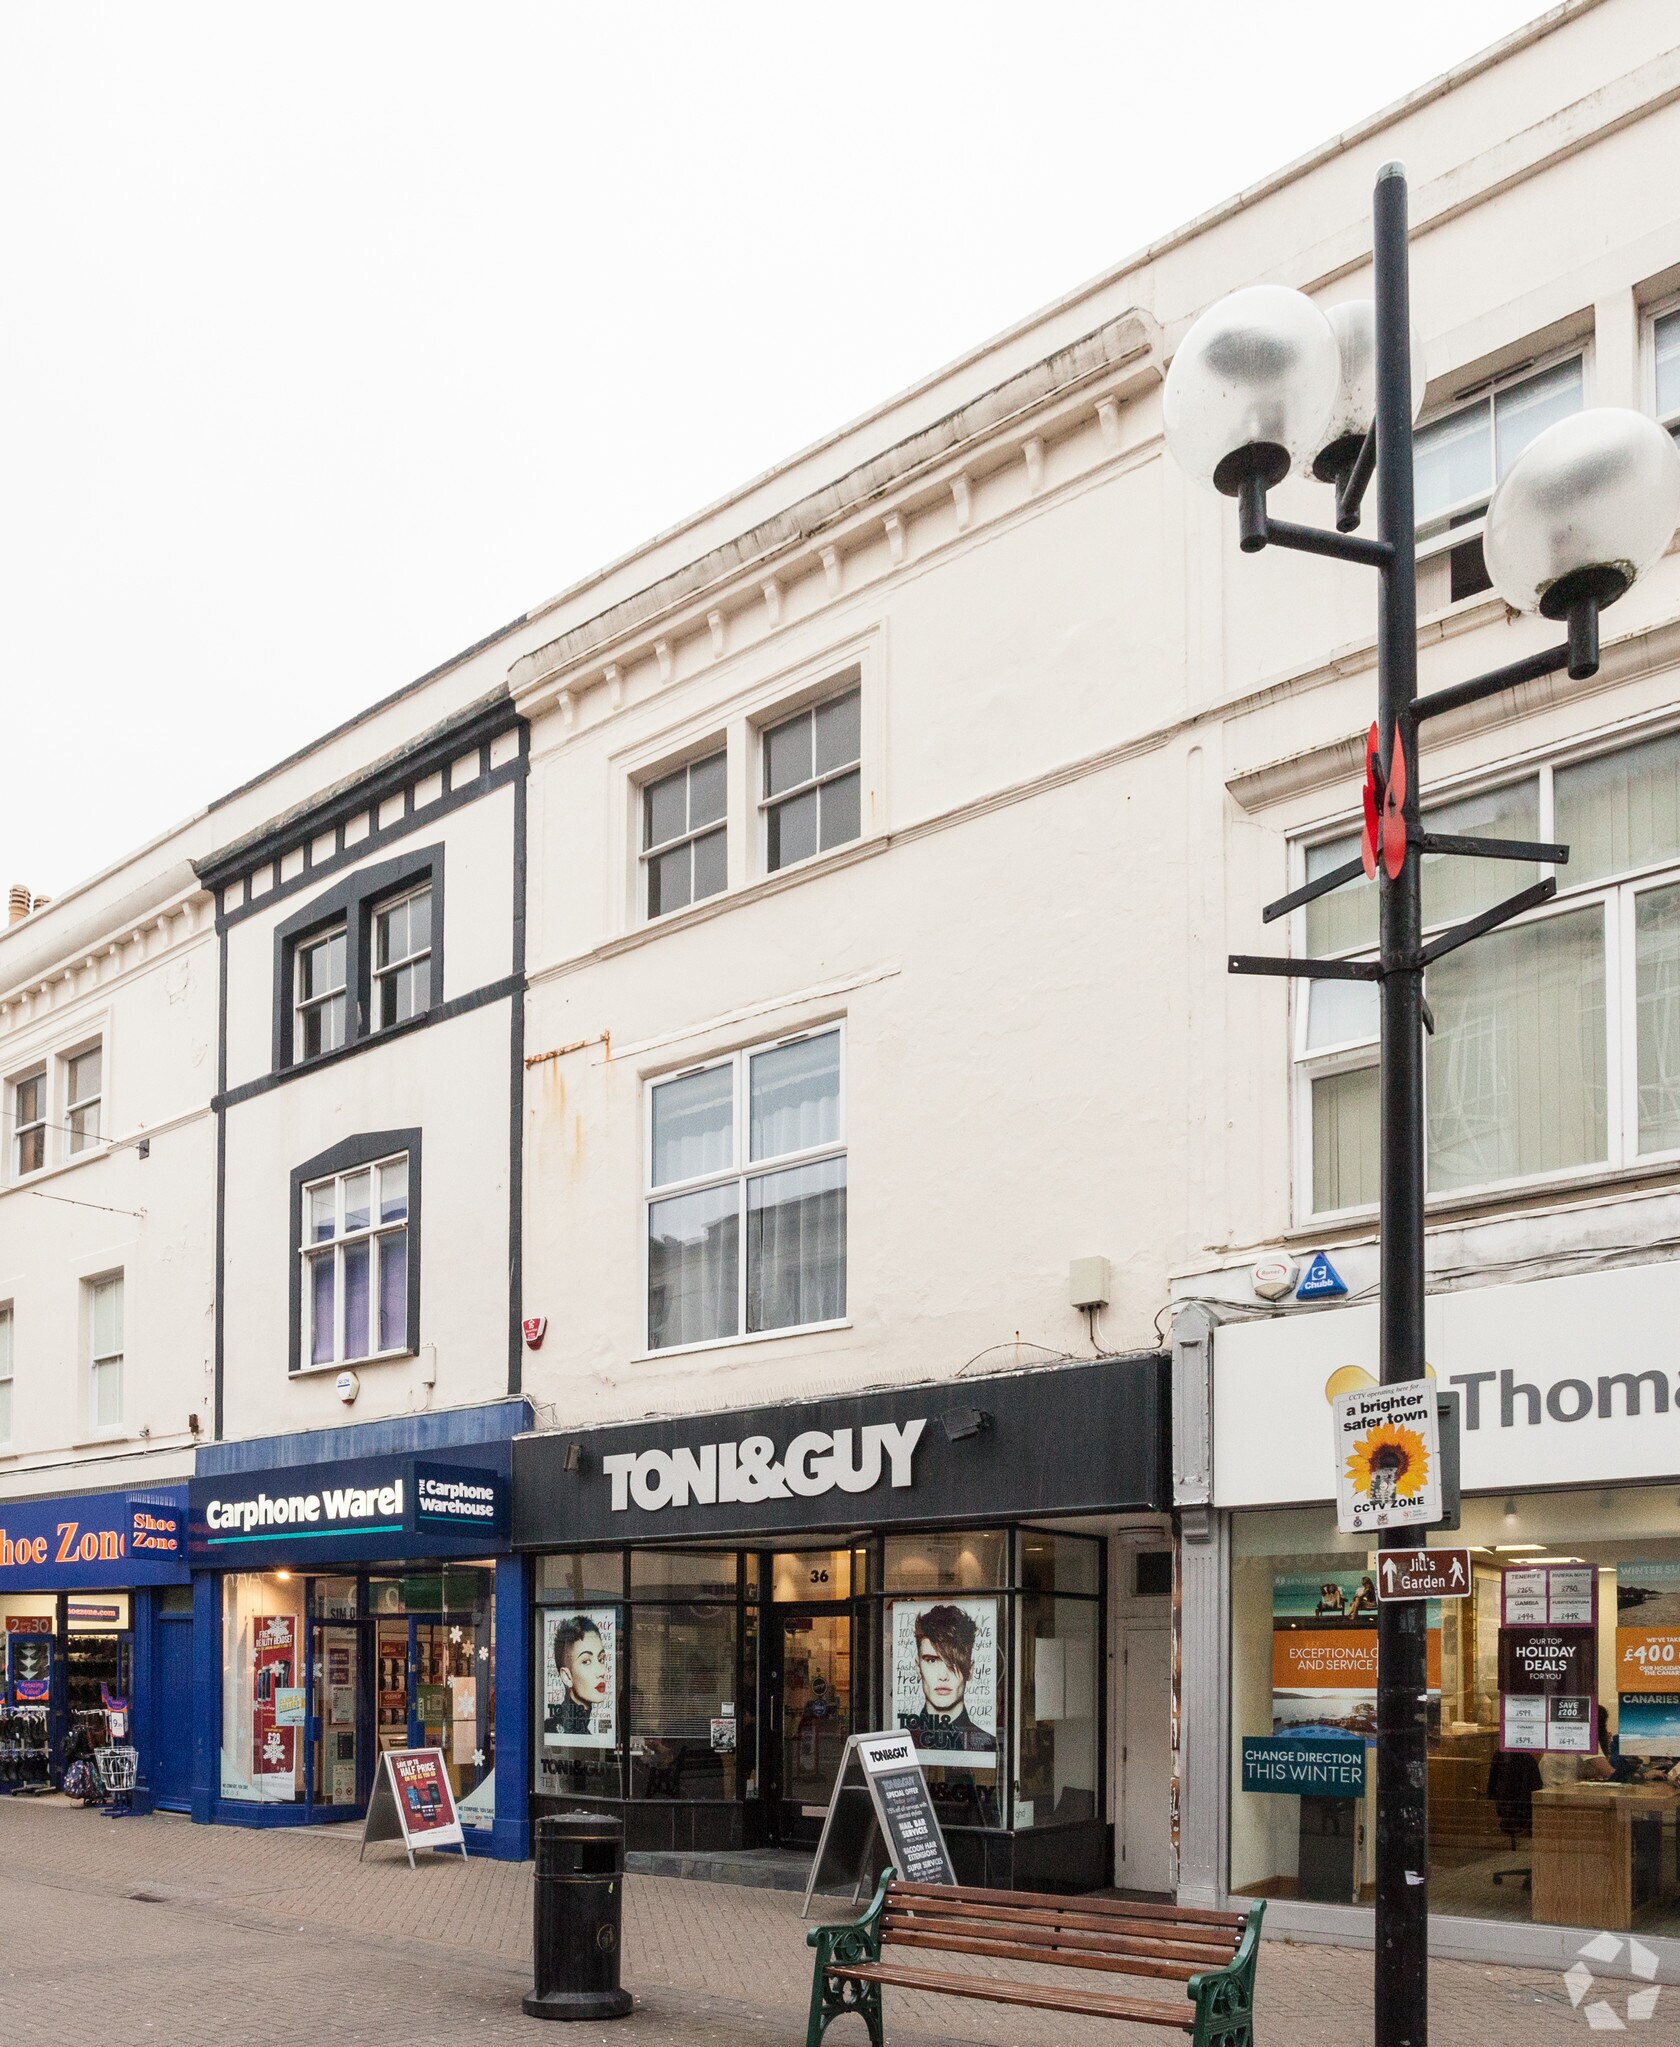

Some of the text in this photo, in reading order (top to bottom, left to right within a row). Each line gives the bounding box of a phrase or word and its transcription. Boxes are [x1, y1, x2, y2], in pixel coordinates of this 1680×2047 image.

[1304, 1279, 1334, 1290] Chubb
[1348, 1392, 1367, 1401] CCTV
[1366, 1387, 1395, 1399] operating
[1395, 1385, 1409, 1393] here
[1346, 1394, 1424, 1416] a brighter
[1343, 1409, 1428, 1431] safer town
[603, 1418, 927, 1511] TONI&GUY
[426, 1479, 494, 1501] Carphone
[419, 1497, 494, 1517] Warehouse
[1354, 1496, 1425, 1513] CCTV ZONE
[206, 1494, 320, 1531] Carphone
[133, 1513, 177, 1532] Shoe
[55, 1522, 125, 1563] Zon
[132, 1532, 178, 1550] Zone
[1409, 1557, 1436, 1572] Jill's
[1620, 1565, 1664, 1576] WINTER
[810, 1570, 829, 1583] 36
[1401, 1575, 1446, 1590] Garden
[331, 1607, 346, 1620] SIM
[11, 1618, 20, 1632] 2
[897, 1639, 914, 1648] style
[1547, 1637, 1563, 1645] TOP
[1289, 1647, 1371, 1659] EXCEPTIONAL
[1515, 1646, 1577, 1658] HOLIDAY
[1623, 1644, 1675, 1665] £400
[1297, 1659, 1373, 1670] AND SERVICE
[1524, 1660, 1567, 1671] DEALS
[1558, 1701, 1579, 1709] SAVE
[1622, 1694, 1680, 1704] CANARIES
[1557, 1709, 1578, 1717] £200
[897, 1713, 955, 1731] TONI&
[920, 1730, 963, 1749] GUY
[869, 1746, 909, 1763] TONI&GUY
[1245, 1750, 1362, 1764] CHANGE DIRECTION
[400, 1762, 436, 1777] HALF PRICE
[1245, 1763, 1362, 1783] THIS WINTER
[886, 1787, 919, 1799] SPECIAL OFFER
[1015, 1809, 1026, 1822] ghd
[898, 1818, 927, 1831] NAIL BAR
[901, 1826, 928, 1838] SERVICES
[903, 1840, 938, 1855] RACOON HAIR
[907, 1848, 938, 1861] EXTENSIONS
[907, 1862, 922, 1873] SUPER
[922, 1857, 943, 1869] SERVICES
